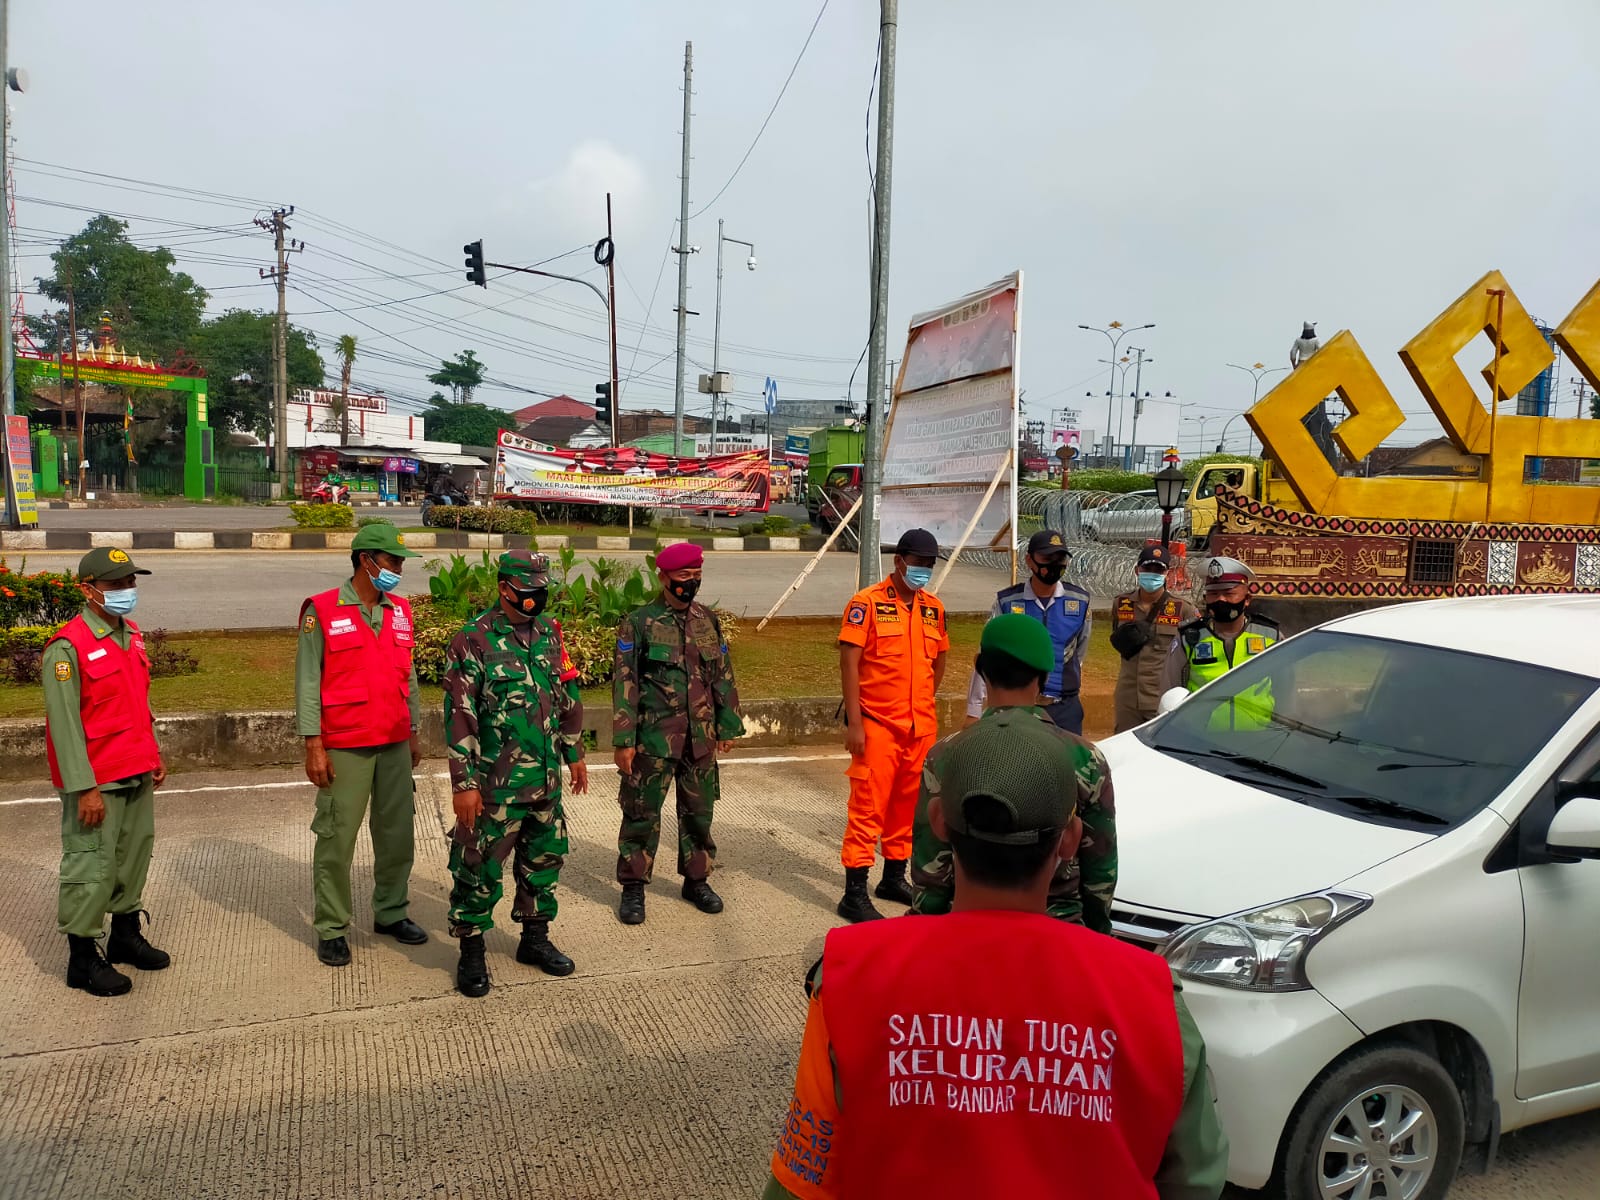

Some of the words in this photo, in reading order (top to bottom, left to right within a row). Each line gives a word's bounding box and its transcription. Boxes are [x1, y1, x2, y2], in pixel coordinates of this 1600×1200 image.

[514, 480, 543, 488] MOHON
[545, 482, 590, 490] KERJASAMA
[520, 488, 562, 496] PROTOKOL
[564, 491, 608, 499] KESEHATAN
[546, 472, 577, 482] MAAF
[580, 475, 645, 486] PERJALANAN
[650, 478, 678, 487] ANDA
[888, 1013, 1004, 1051] SATUAN
[1024, 1018, 1118, 1060] TUGAS
[888, 1049, 1112, 1091] KELURAHAN
[889, 1079, 935, 1107] KOTA
[946, 1083, 1017, 1114] BANDAR
[1028, 1089, 1113, 1122] LAMPUNG
